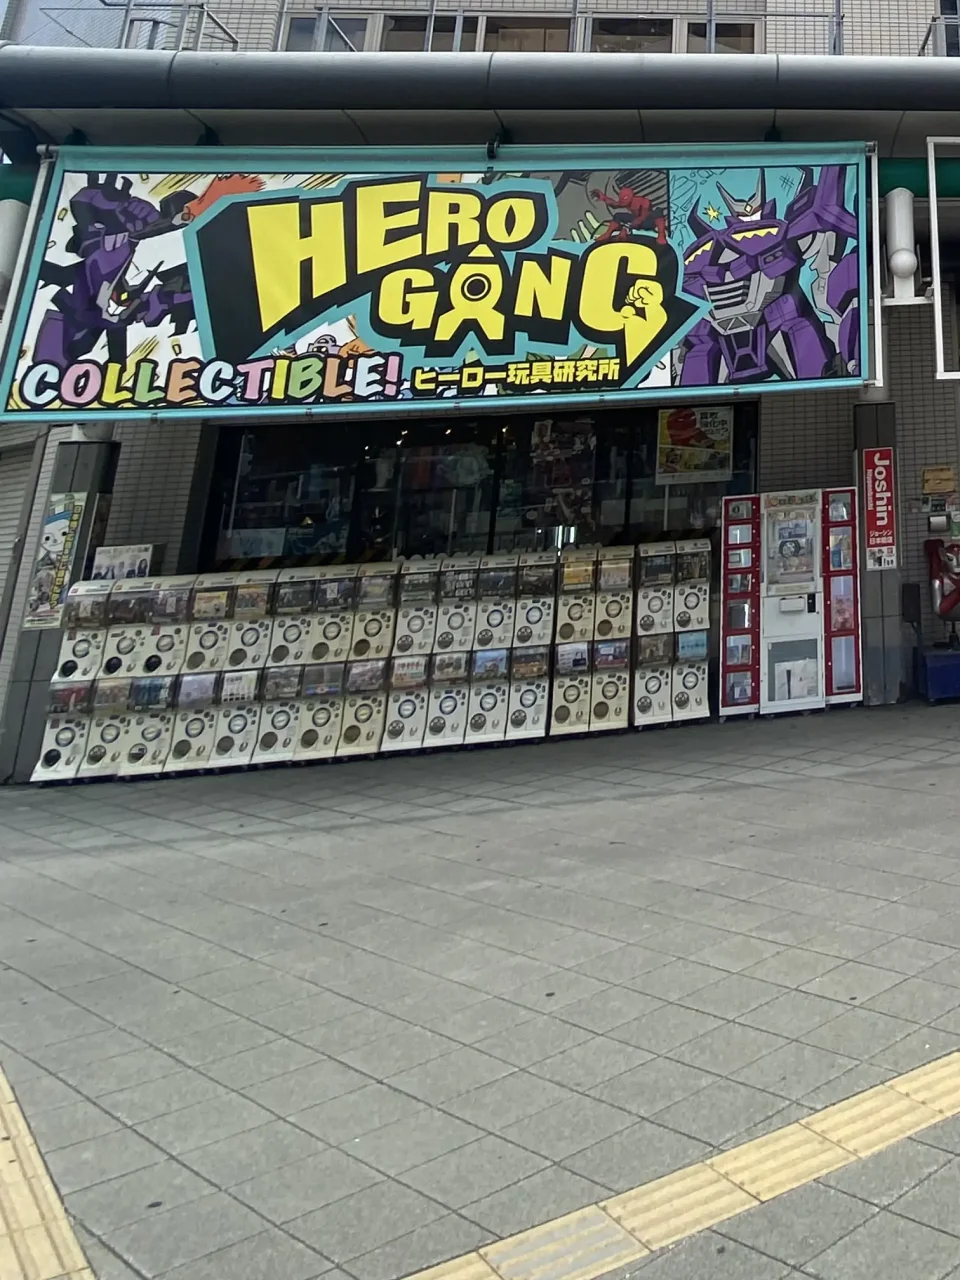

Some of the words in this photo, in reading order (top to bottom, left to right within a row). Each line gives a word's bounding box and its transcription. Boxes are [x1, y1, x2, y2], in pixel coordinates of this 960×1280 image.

[246, 181, 533, 334] HERO
[377, 242, 668, 365] GANG
[20, 354, 402, 408] COLLECTIBLE!
[413, 358, 621, 392] ヒーロー玩具研究所
[873, 452, 893, 527] Joshin
